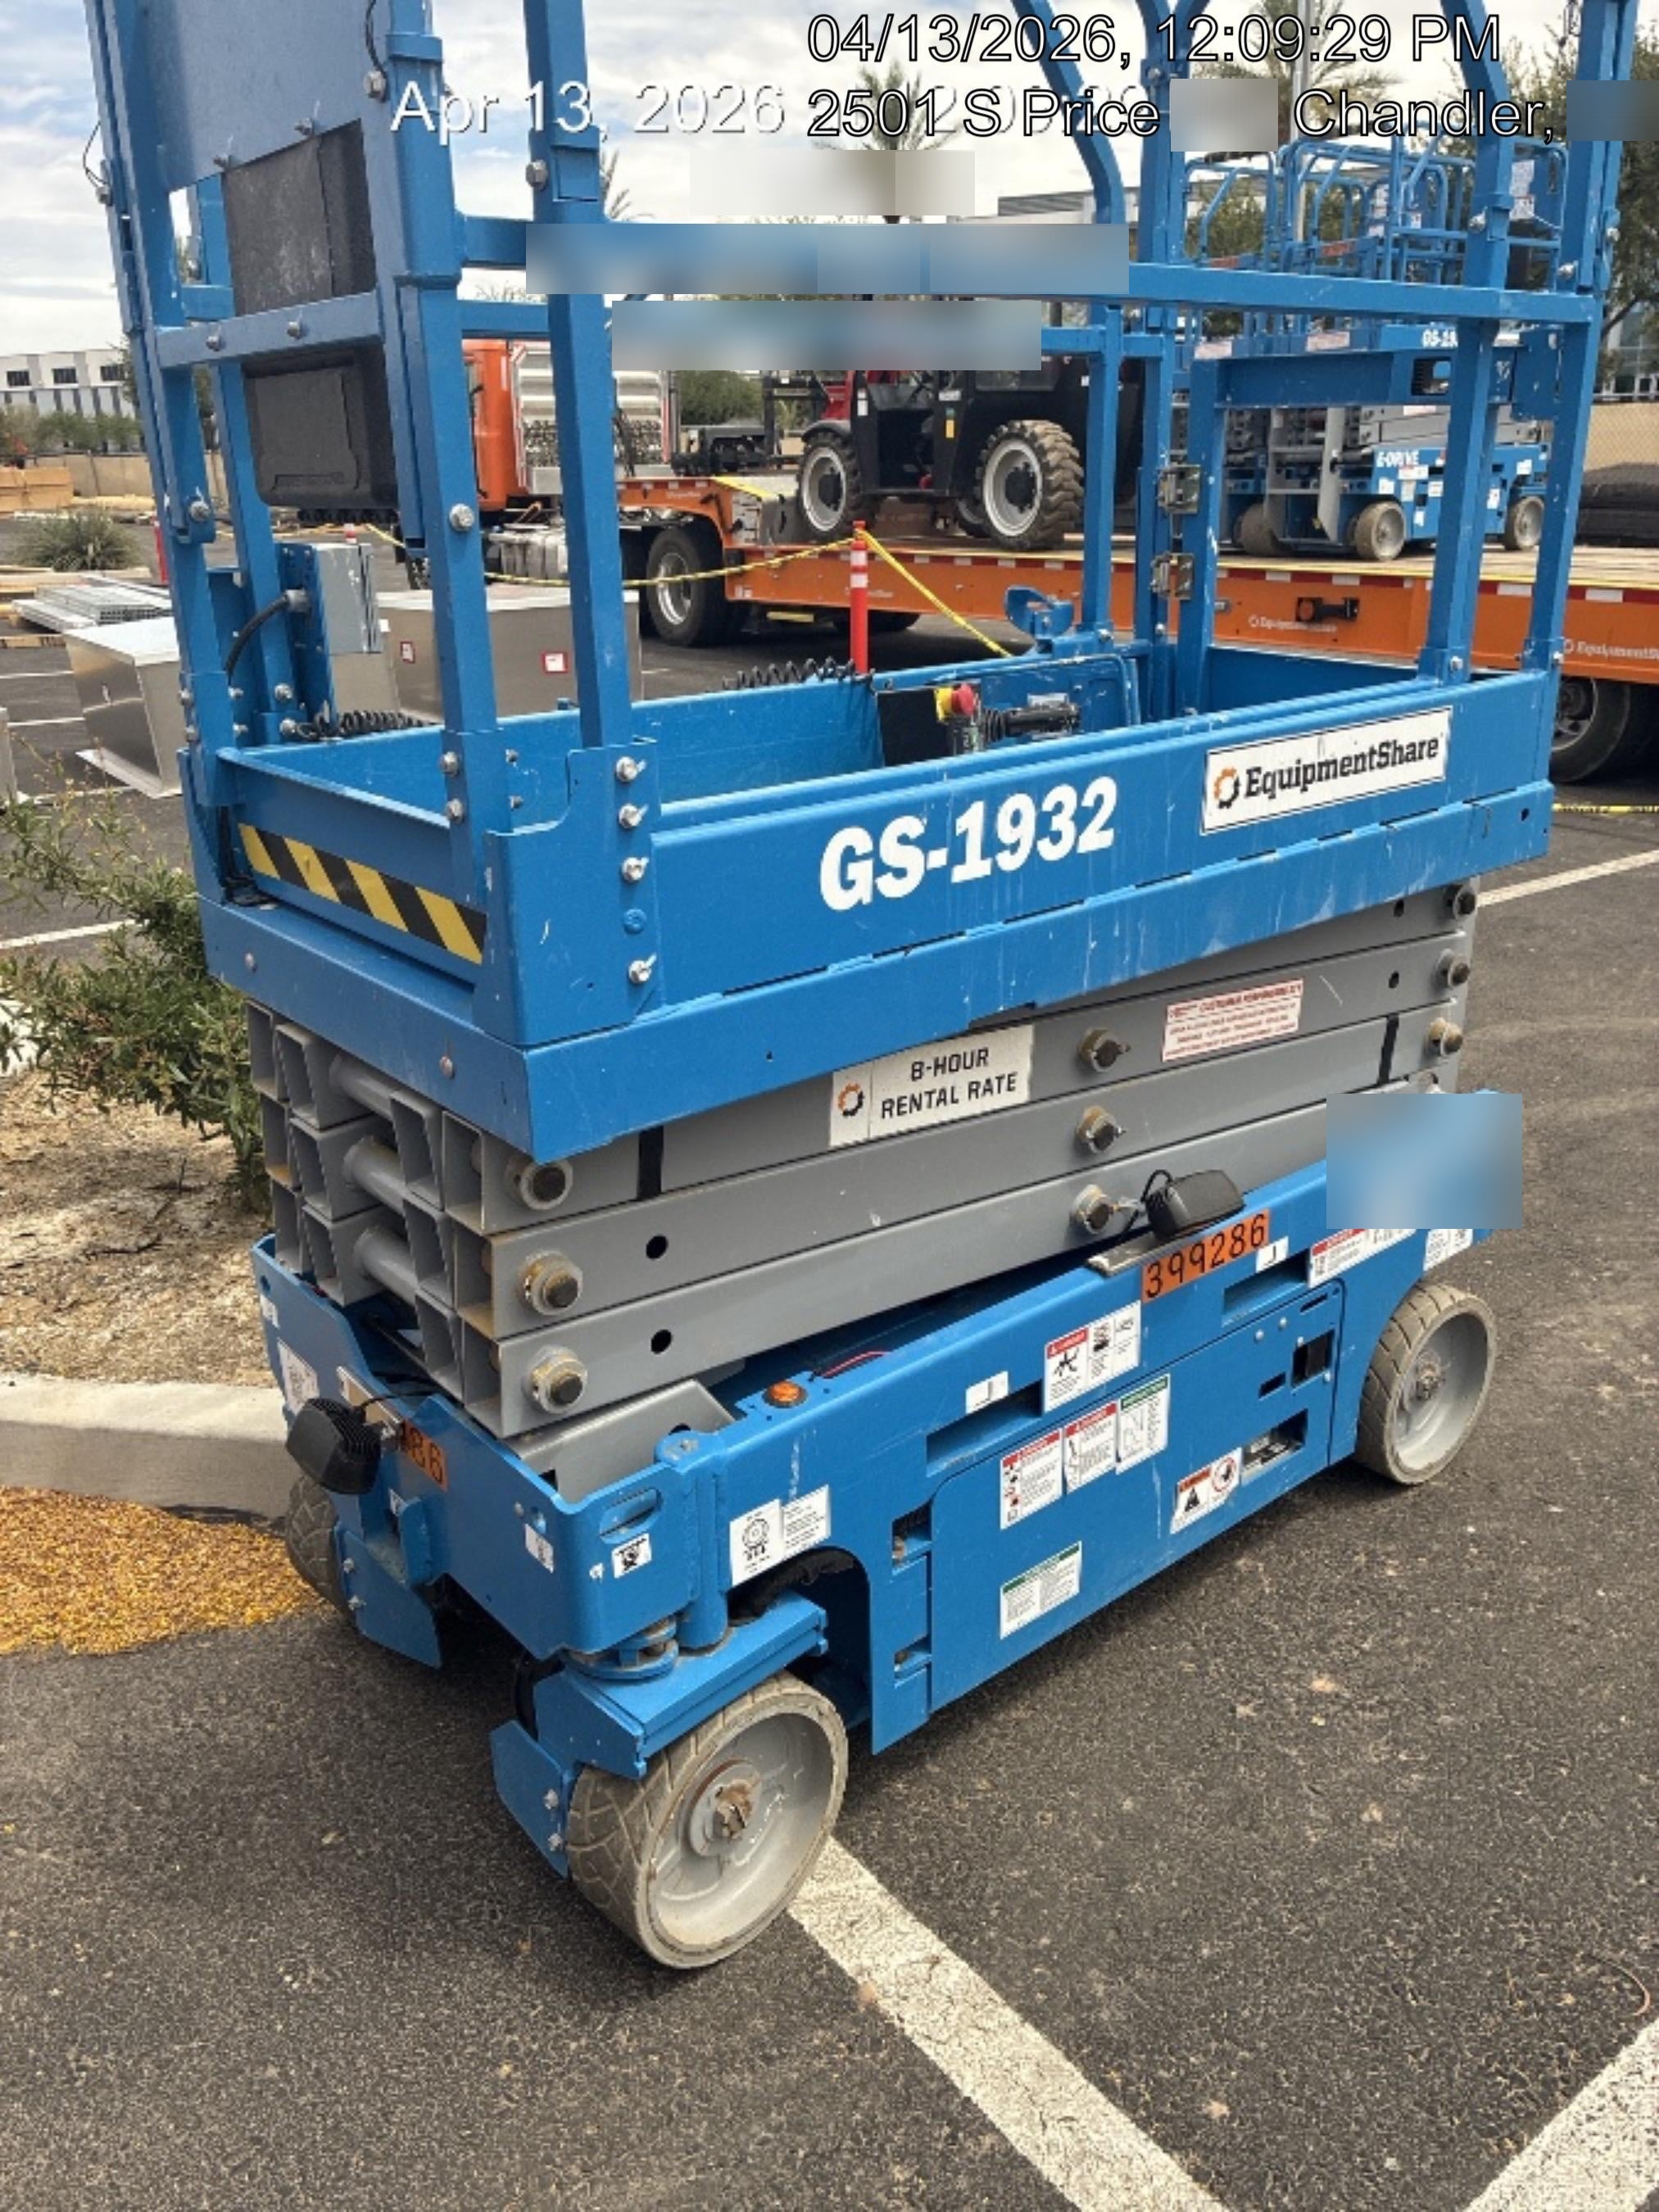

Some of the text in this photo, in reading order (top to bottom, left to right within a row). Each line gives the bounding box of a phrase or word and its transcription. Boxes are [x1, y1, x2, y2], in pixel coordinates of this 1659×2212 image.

[1244, 737, 1439, 800] EquipmentShare
[820, 776, 1117, 911] GS-1932
[911, 1047, 990, 1081] 8-HOUR
[882, 1072, 1018, 1120] RENTAL RATE
[1145, 1213, 1265, 1299] 399286
